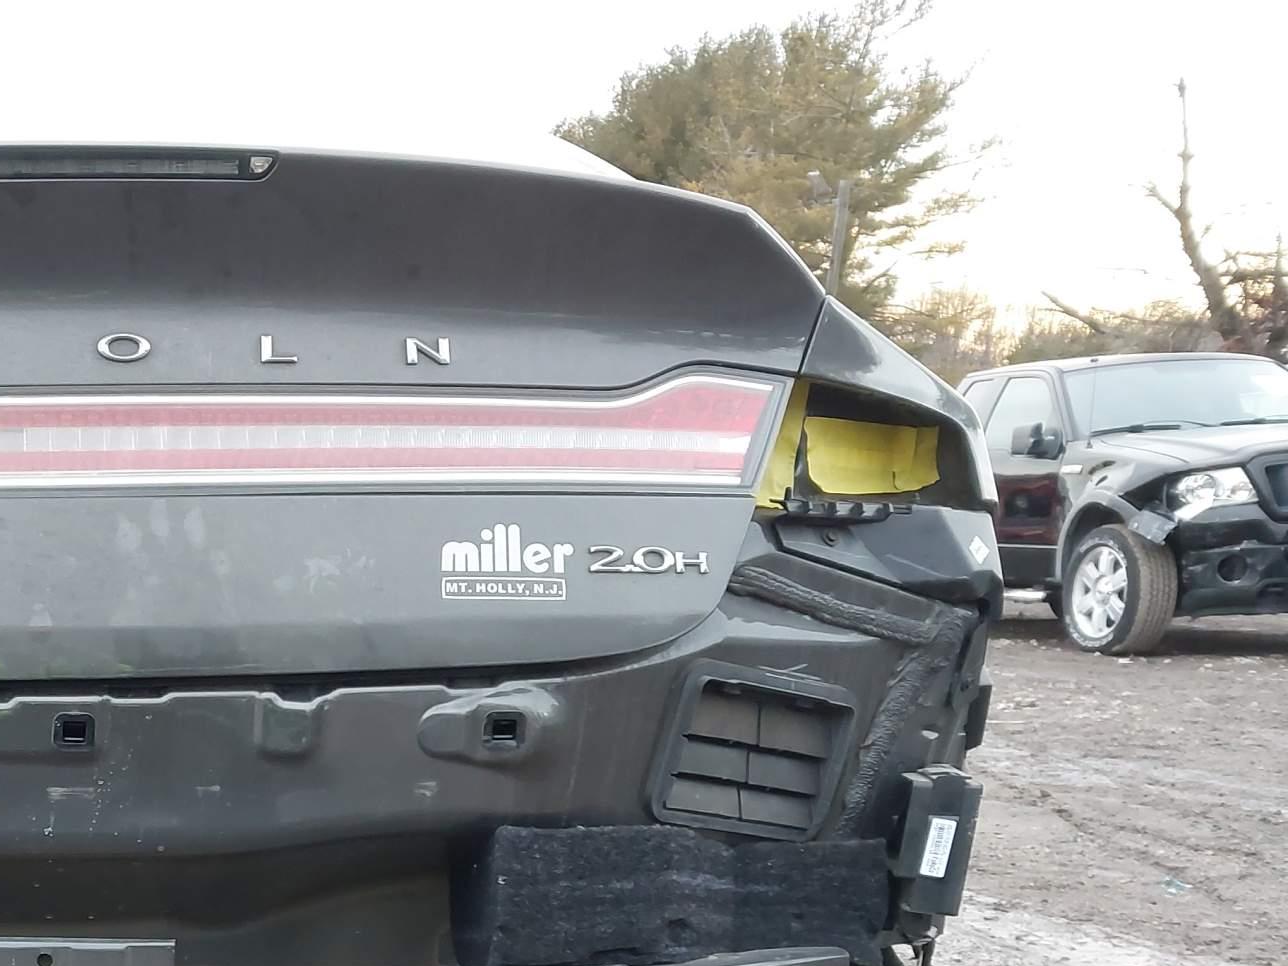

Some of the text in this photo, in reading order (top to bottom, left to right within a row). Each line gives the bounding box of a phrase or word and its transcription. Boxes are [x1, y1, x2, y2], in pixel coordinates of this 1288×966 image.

[441, 523, 574, 573] miller
[589, 545, 710, 574] 2.0H
[446, 582, 562, 595] MT. HOLLY, N.J.
